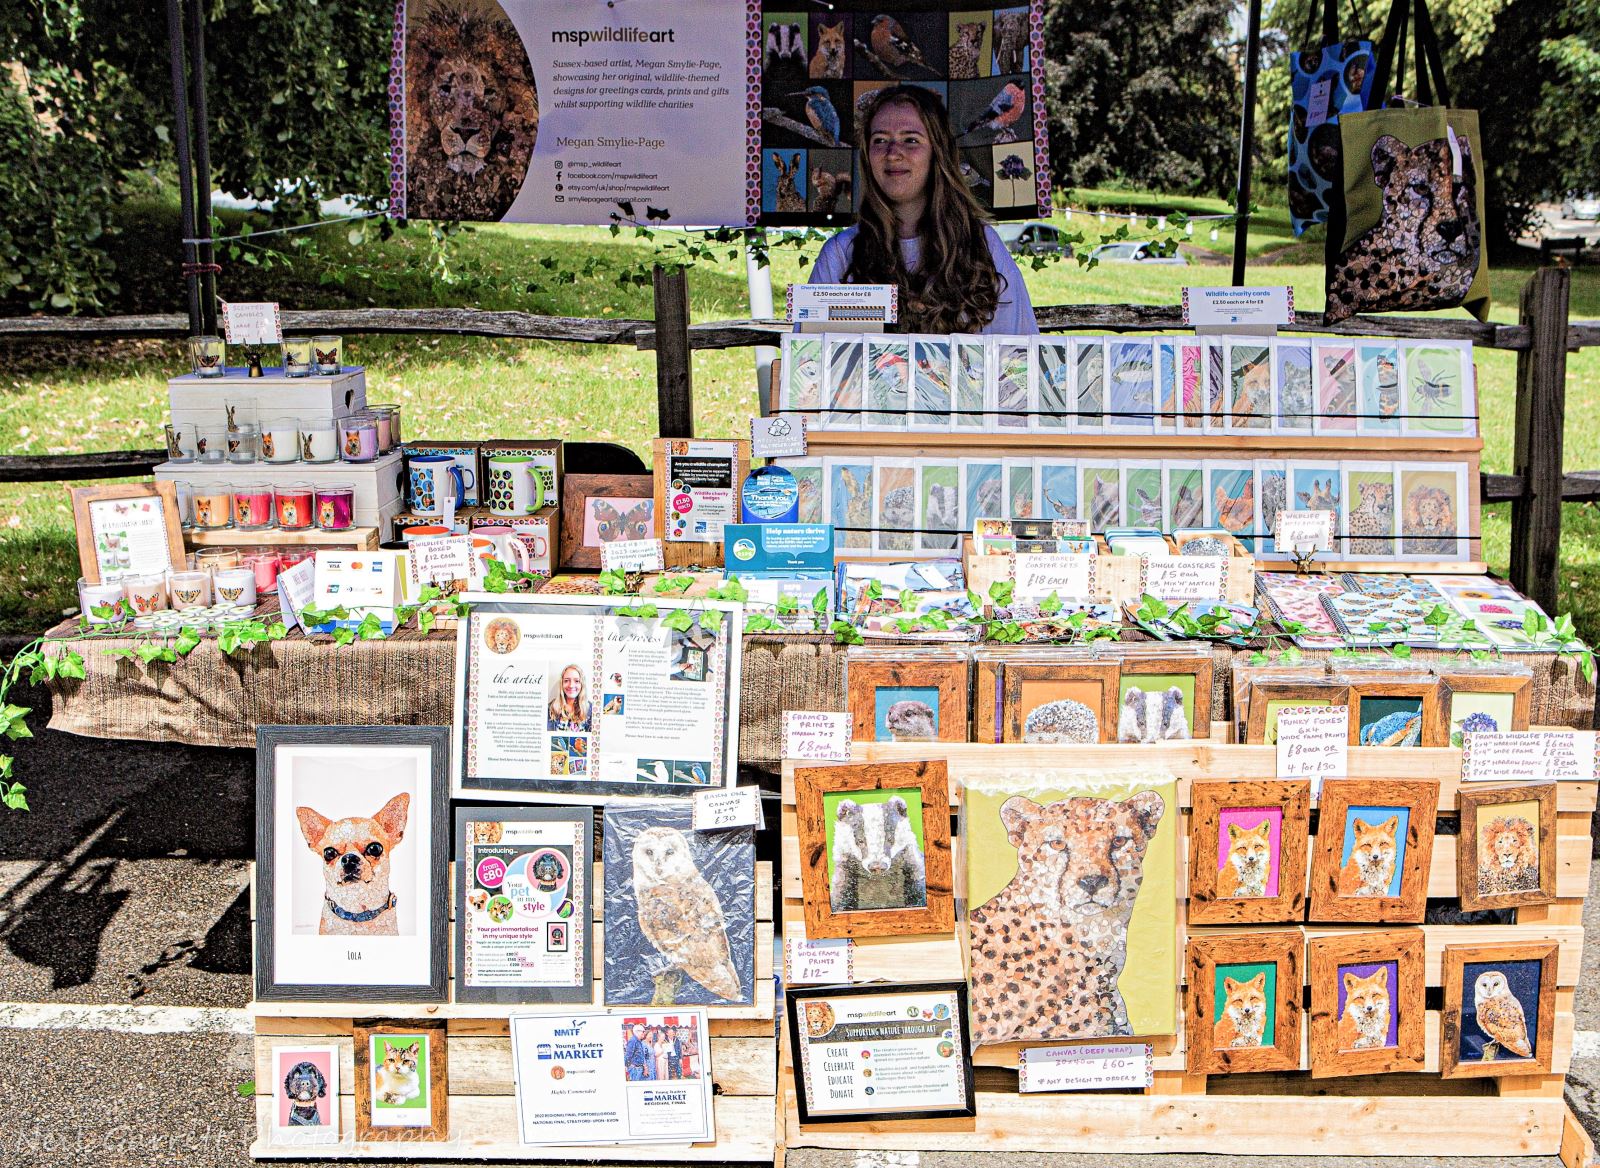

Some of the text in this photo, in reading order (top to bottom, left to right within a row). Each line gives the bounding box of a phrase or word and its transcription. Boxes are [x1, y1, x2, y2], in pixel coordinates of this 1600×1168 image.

[552, 26, 674, 46] mspwildlifeart
[552, 60, 722, 70] Sussex-based artist, Megan Smylie-Page,
[552, 72, 720, 82] showcasing her original, wildlife-themed
[553, 86, 730, 97] designs for greetings cards, prints and gifts
[554, 100, 694, 110] whilst supporting wildlife charities
[556, 137, 665, 150] Megan Smylie-Page
[567, 172, 658, 181] facebook.com/mspwildlifeart
[751, 494, 775, 502] Thank
[416, 540, 444, 548] WILDLIFE
[1028, 573, 1046, 587] £18
[1161, 570, 1177, 580] £5
[493, 664, 543, 684] the artist
[1559, 740, 1574, 748] each
[1288, 744, 1302, 758] £8
[1288, 762, 1336, 774] 4 for £30
[709, 799, 740, 808] CANVAS
[715, 815, 736, 824] £30
[482, 862, 499, 872] from
[483, 868, 503, 882] £80
[510, 886, 530, 899] pet
[523, 901, 545, 912] style
[347, 951, 362, 961] LOLA
[848, 1010, 896, 1020] mspwildlifeart
[554, 1028, 580, 1037] NMTF
[846, 1024, 936, 1038] SUPPORTING NATURE THROUGH ART
[554, 1049, 604, 1060] MARKET
[827, 1047, 848, 1058] CREATE
[1046, 1049, 1077, 1057] CANVAS
[824, 1061, 855, 1072] CELEBRATE
[828, 1075, 853, 1086] EDUCATE
[830, 1088, 854, 1100] DONATE
